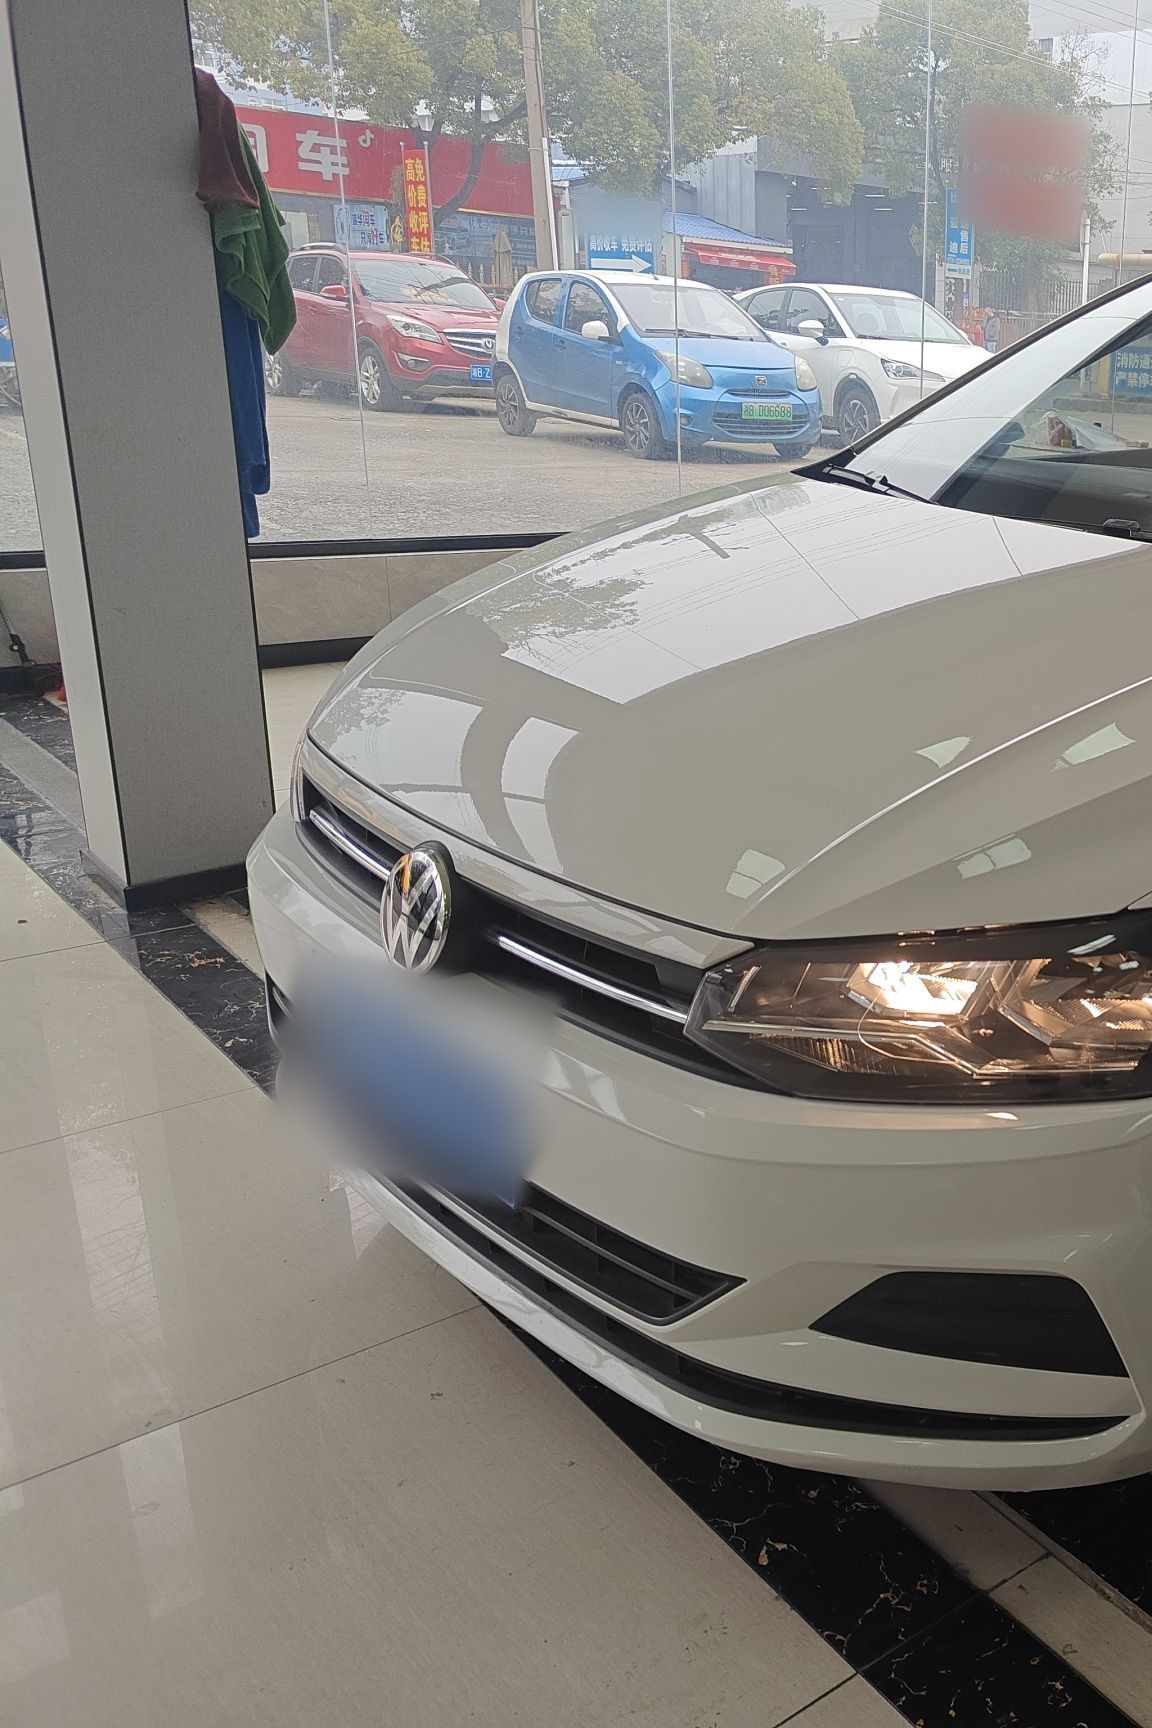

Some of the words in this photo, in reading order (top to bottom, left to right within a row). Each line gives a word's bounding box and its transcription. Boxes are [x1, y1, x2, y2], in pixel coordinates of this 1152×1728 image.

[404, 157, 420, 253] 高价收车
[415, 157, 431, 254] 免费评估
[589, 235, 618, 252] 高价收车
[621, 235, 653, 253] 免费评估
